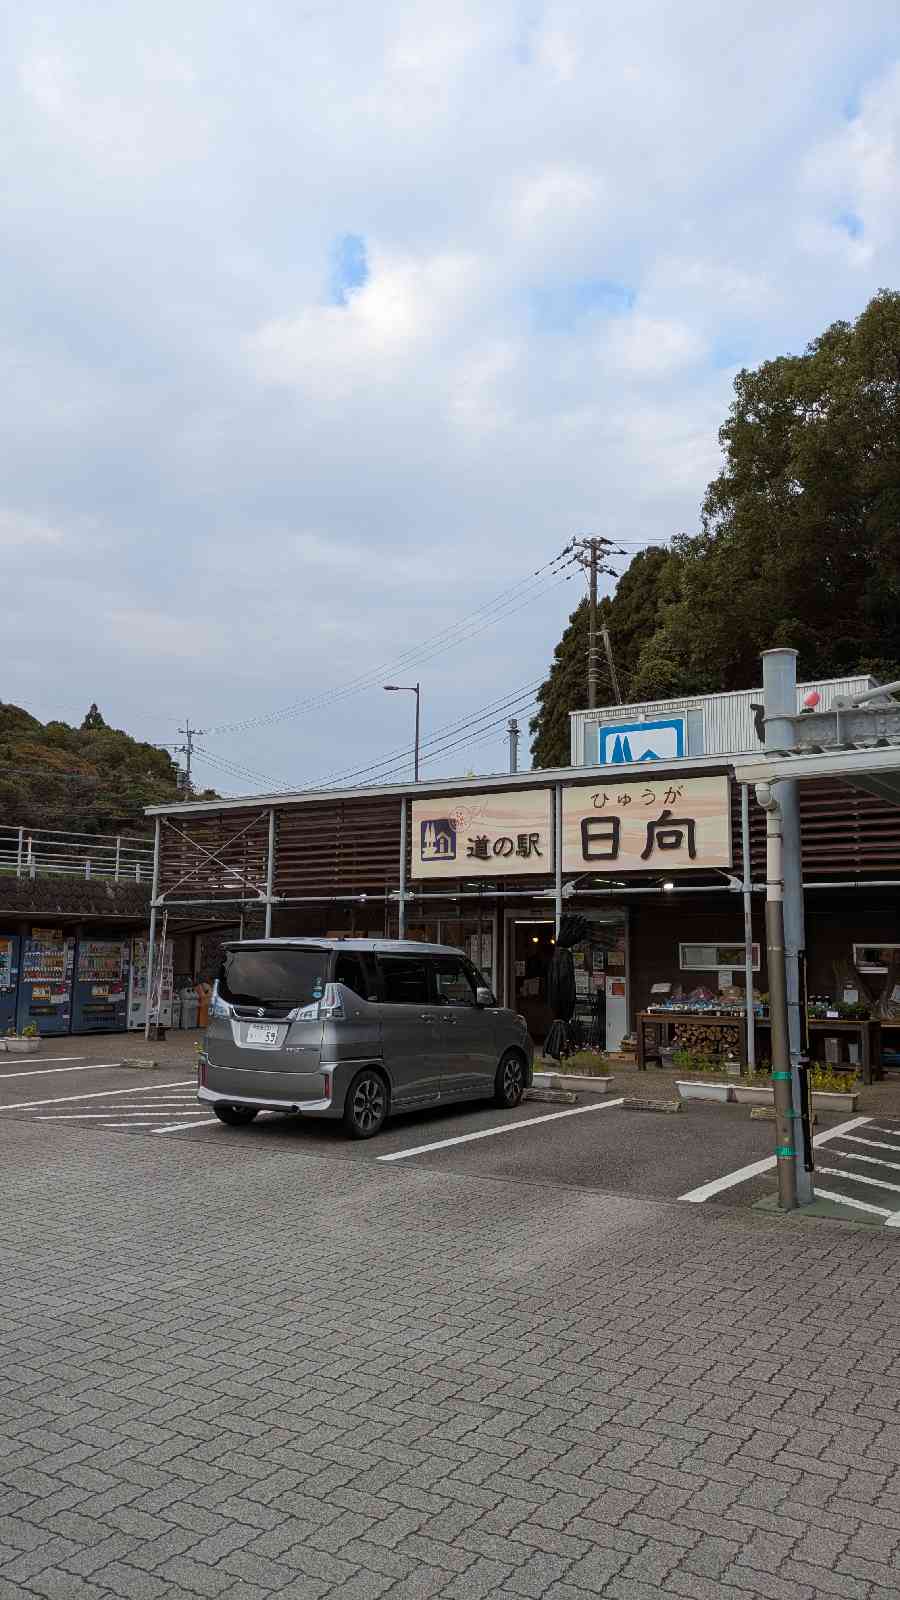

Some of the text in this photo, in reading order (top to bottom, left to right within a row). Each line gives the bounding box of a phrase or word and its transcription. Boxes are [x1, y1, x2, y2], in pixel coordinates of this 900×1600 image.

[590, 785, 684, 809] ひゅうが
[466, 832, 543, 860] 道の駅
[581, 810, 696, 861] 日向
